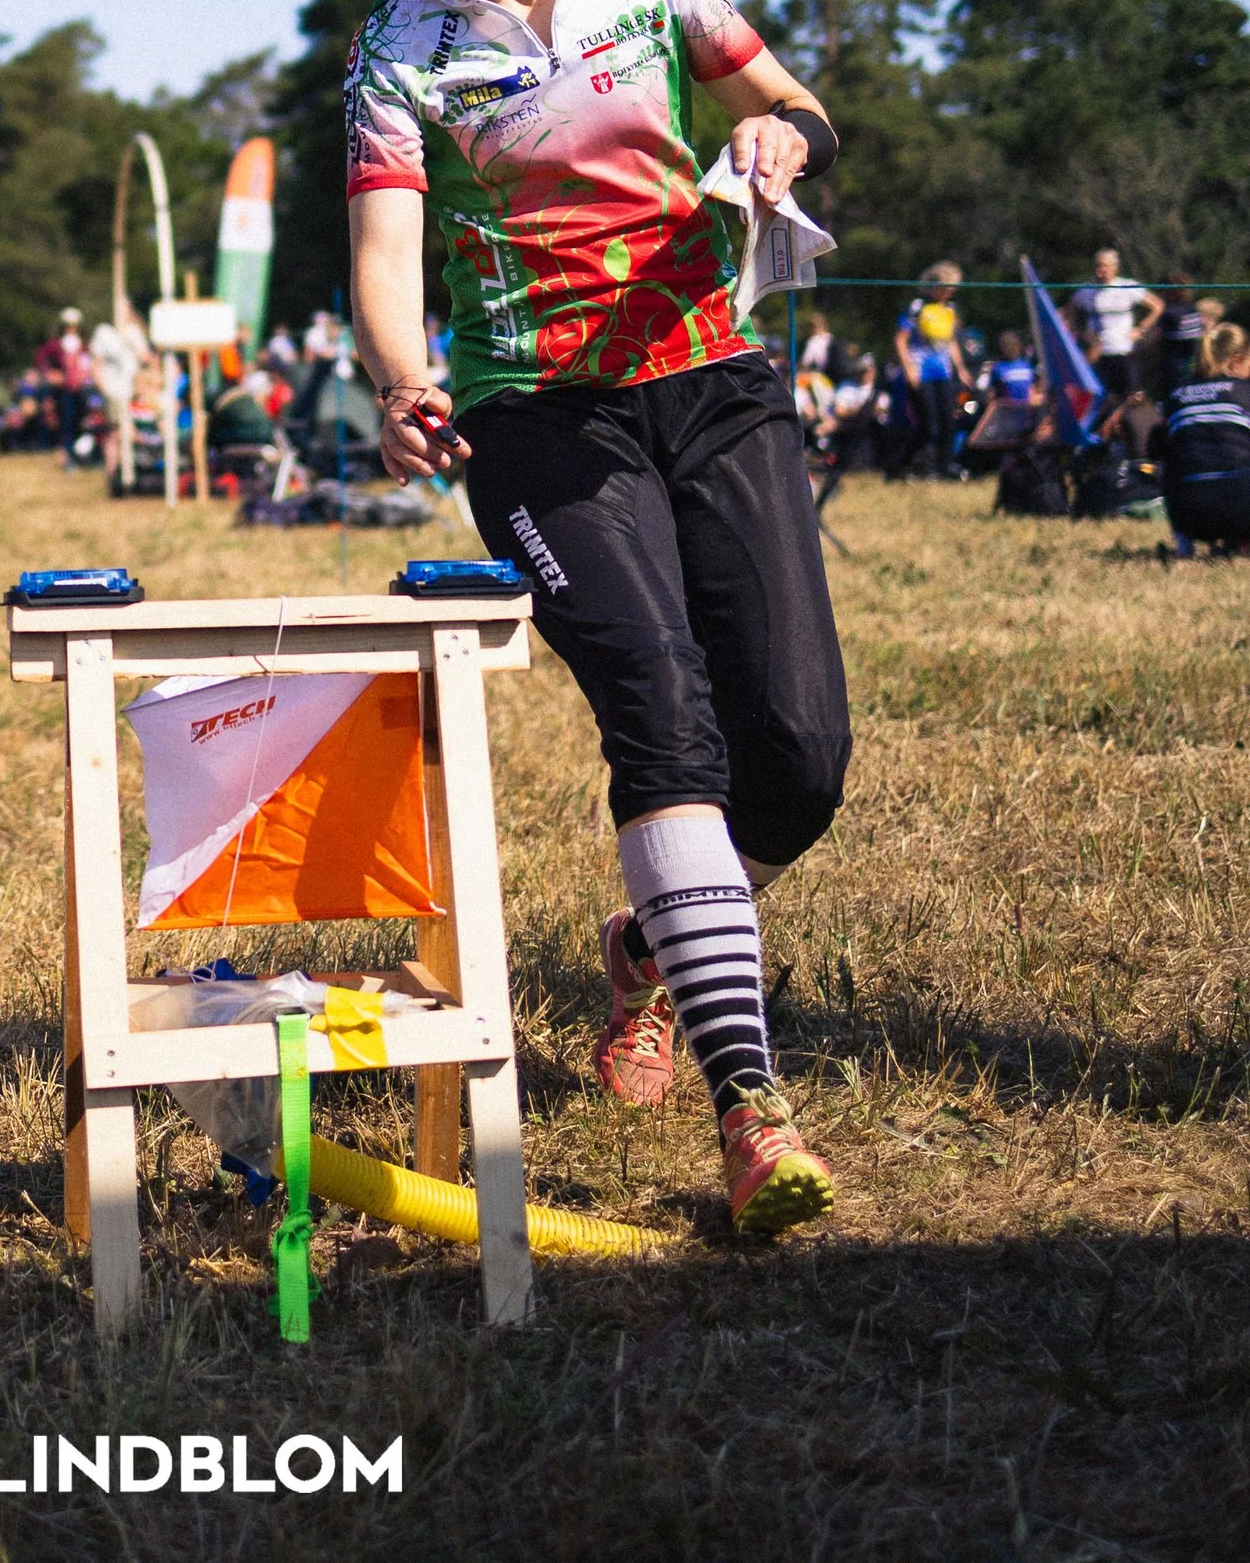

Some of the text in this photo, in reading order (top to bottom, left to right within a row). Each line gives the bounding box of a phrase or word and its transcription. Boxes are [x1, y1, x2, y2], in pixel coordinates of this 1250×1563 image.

[430, 10, 461, 75] TRIMTEX
[460, 87, 502, 108] Mila
[476, 103, 540, 135] RIKSTEN
[504, 245, 519, 281] BIKE
[509, 504, 569, 595] TRIMTEX
